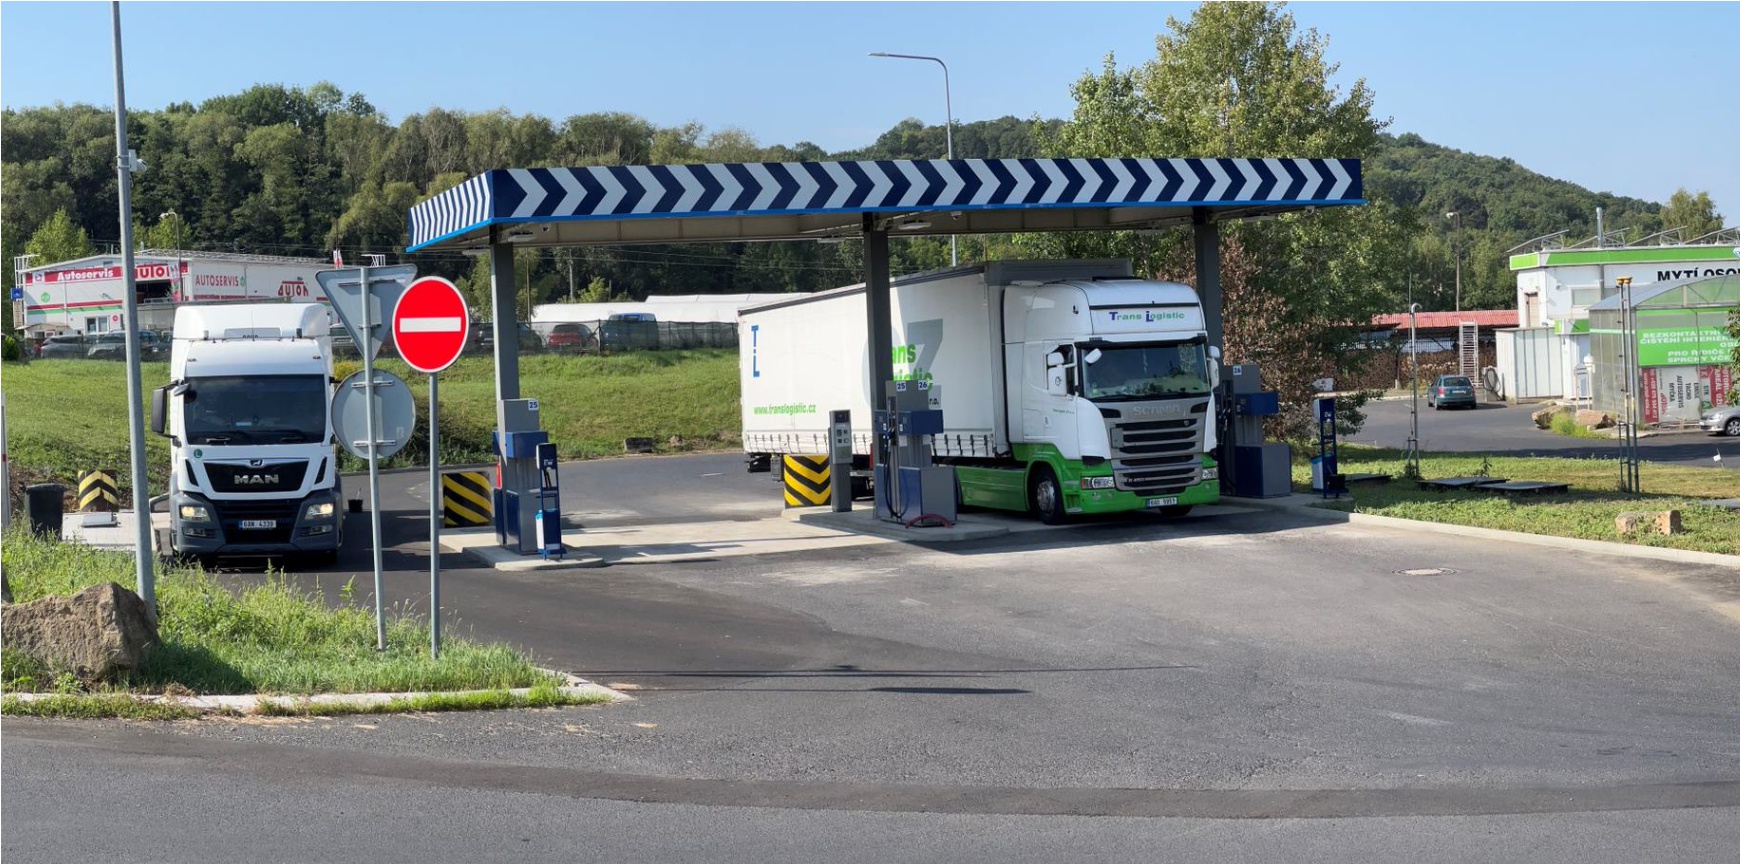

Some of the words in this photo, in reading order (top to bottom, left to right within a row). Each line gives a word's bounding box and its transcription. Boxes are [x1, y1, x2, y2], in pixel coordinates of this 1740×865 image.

[57, 268, 114, 282] Autoservis
[195, 274, 239, 287] AUTOSERVIS
[1657, 267, 1698, 281] MYTÍ
[1109, 311, 1142, 321] Trans
[753, 403, 816, 416] www.translogistic.cz
[1133, 404, 1179, 416] SCANIA
[234, 474, 279, 485] MAN
